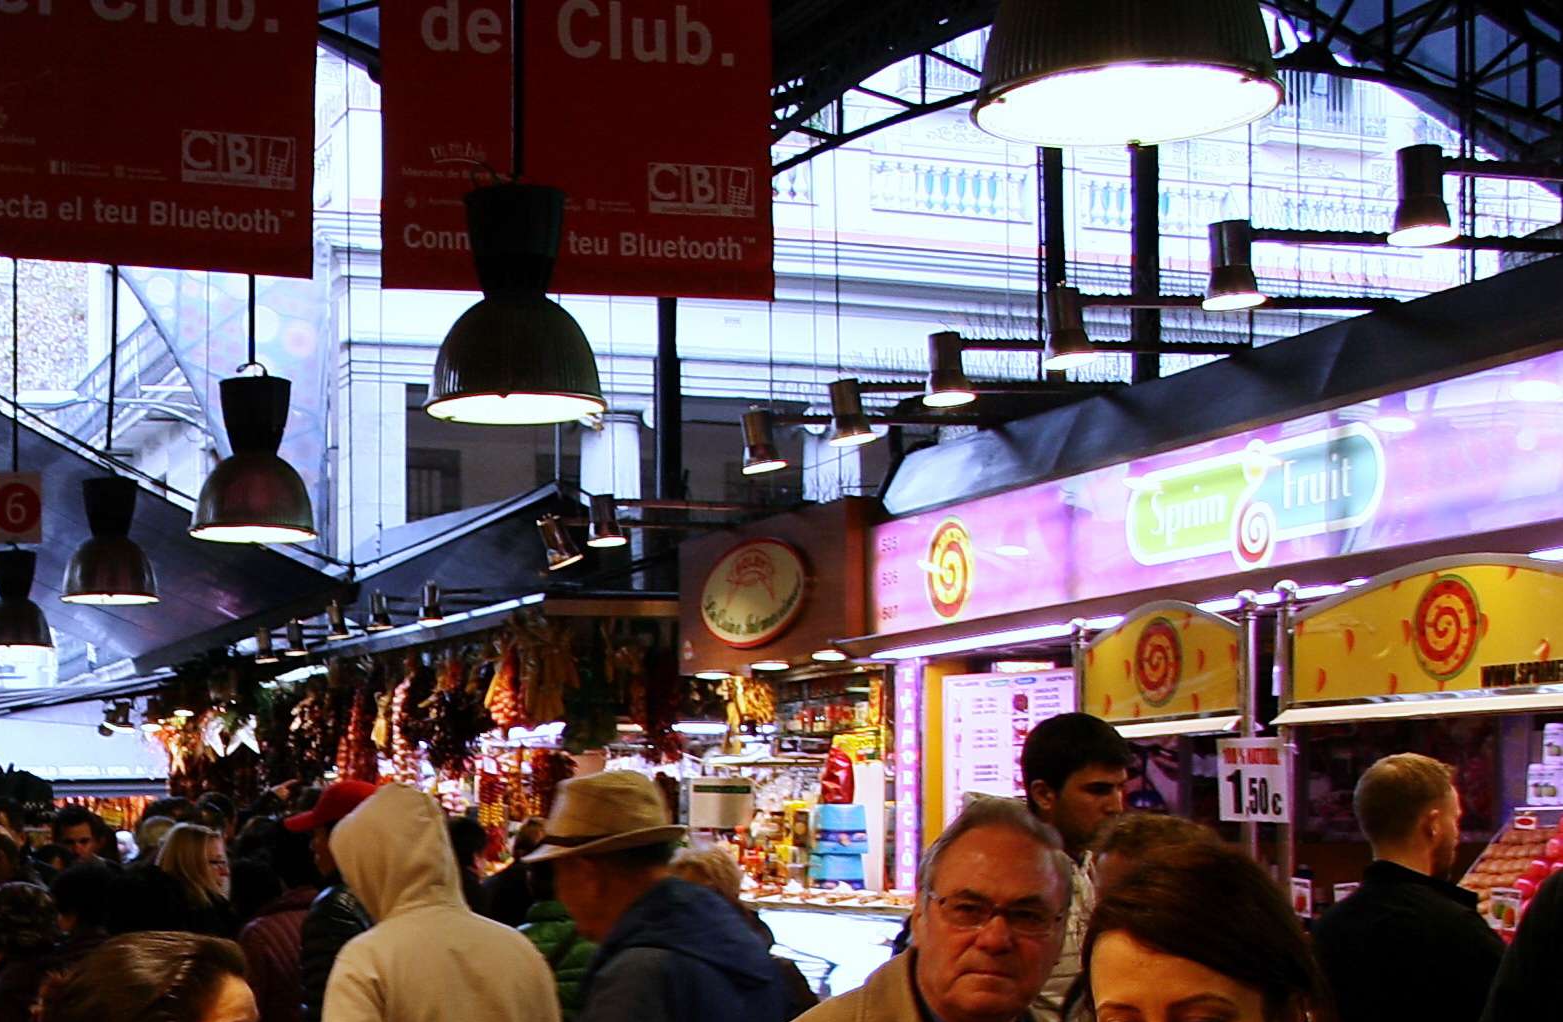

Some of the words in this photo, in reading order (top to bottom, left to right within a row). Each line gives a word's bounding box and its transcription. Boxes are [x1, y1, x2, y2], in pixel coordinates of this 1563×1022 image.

[557, 0, 736, 67] Club.
[58, 195, 83, 222] el
[93, 200, 138, 225] teu
[568, 230, 610, 257] teu
[1282, 453, 1353, 510] Fruit
[5, 491, 28, 524] 6
